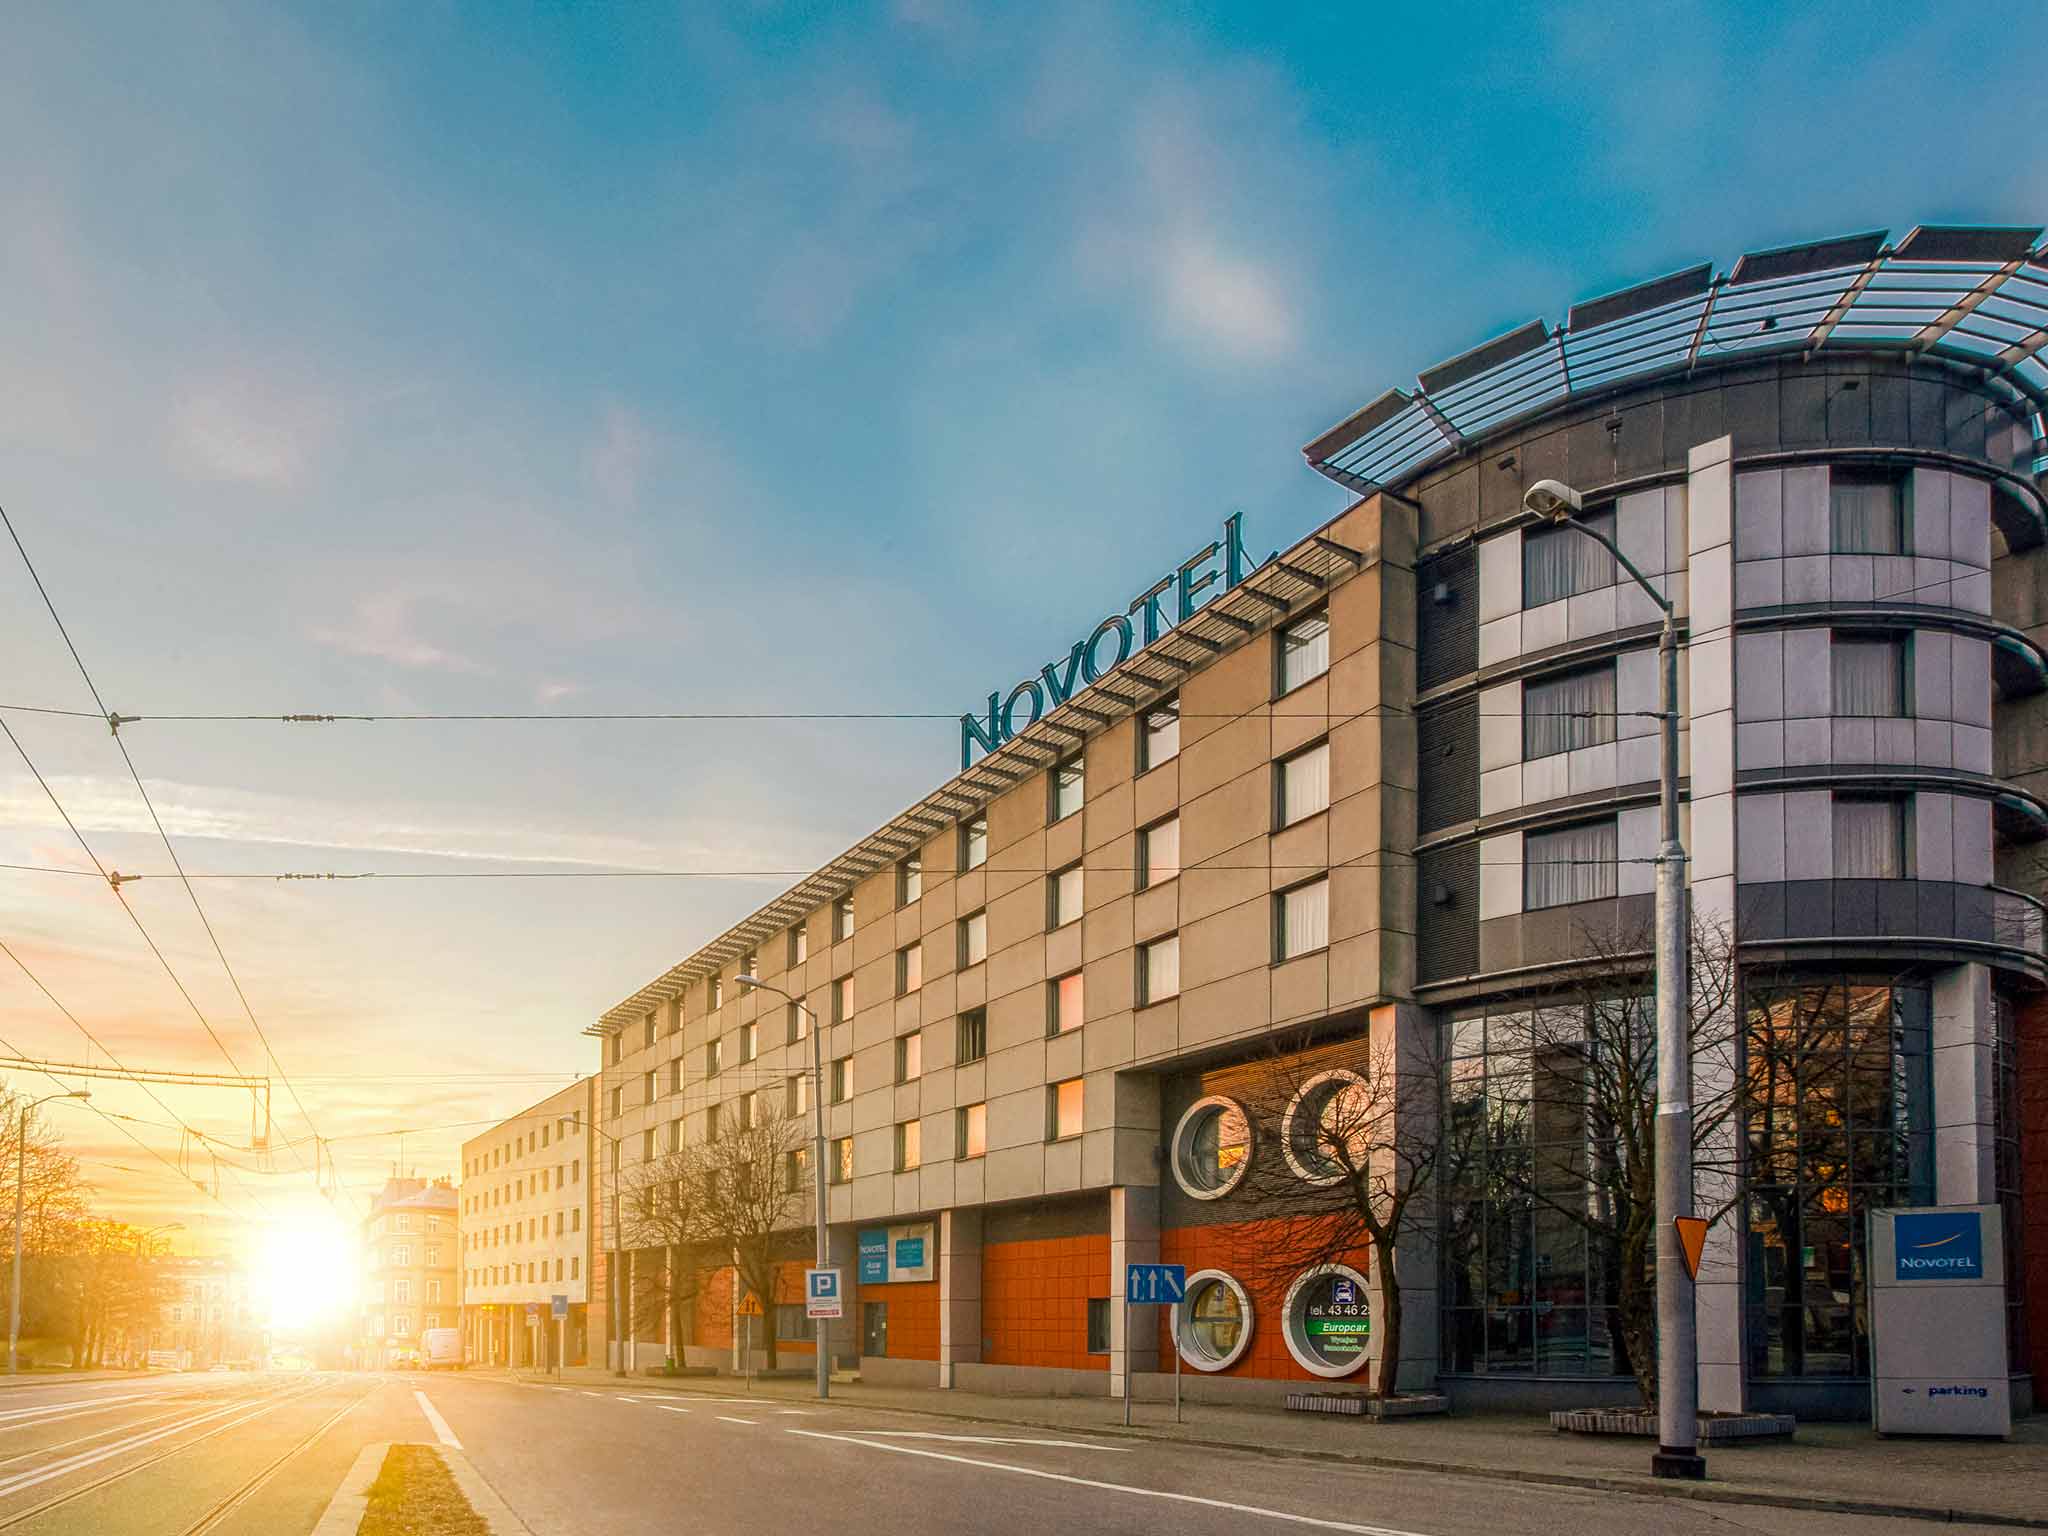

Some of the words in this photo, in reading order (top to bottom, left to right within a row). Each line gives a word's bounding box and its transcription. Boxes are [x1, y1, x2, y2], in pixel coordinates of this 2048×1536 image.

[960, 511, 1279, 771] NOVOTEL
[1901, 1257, 1976, 1268] NOVOTEL
[817, 1275, 831, 1295] P
[1328, 1304, 1341, 1315] 43
[1344, 1304, 1358, 1315] 46
[1361, 1304, 1370, 1315] 2
[1322, 1322, 1367, 1334] Europcar
[1928, 1384, 1988, 1397] parking
